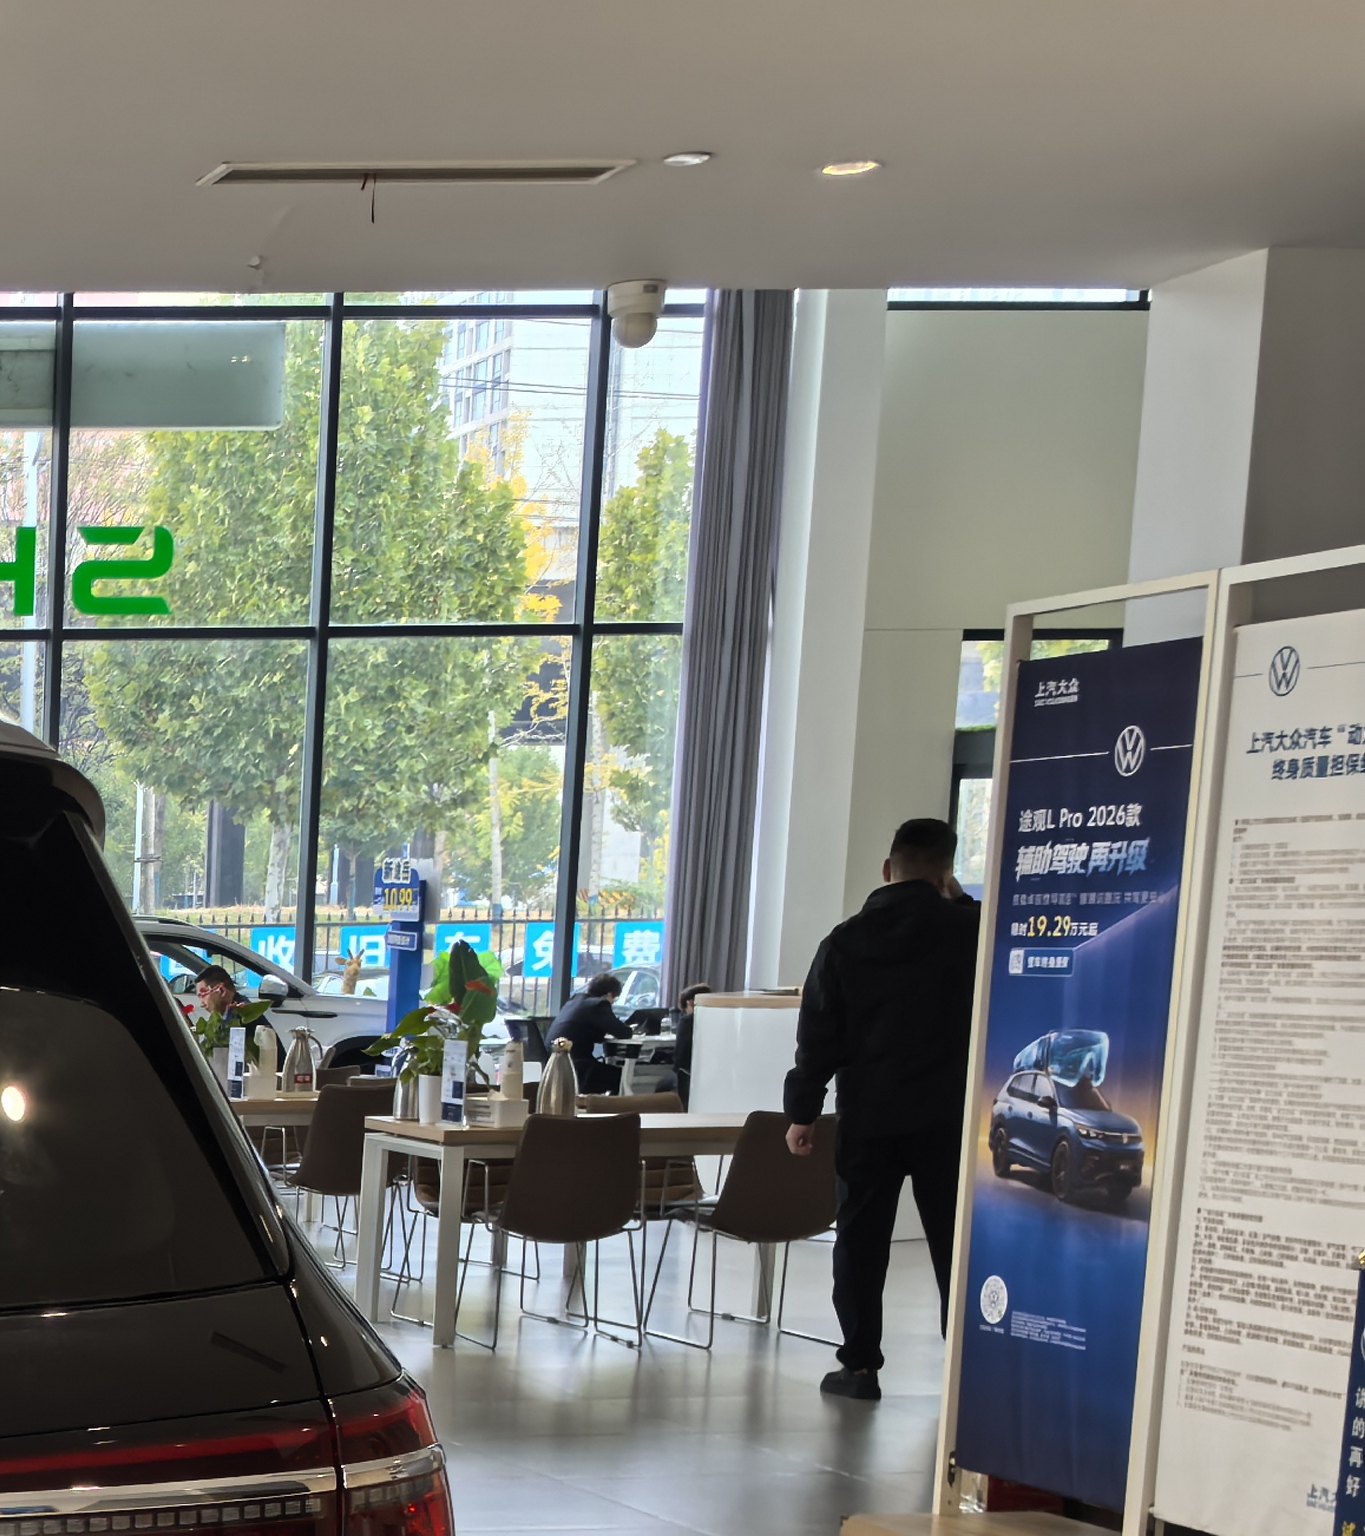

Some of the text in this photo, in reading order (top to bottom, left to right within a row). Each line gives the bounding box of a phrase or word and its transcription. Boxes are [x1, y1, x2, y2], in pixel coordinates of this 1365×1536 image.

[1034, 678, 1080, 698] 上汽大众
[1246, 724, 1365, 754] 上汽大众汽车“动
[1271, 753, 1365, 780] 终身质量担保
[1059, 808, 1083, 828] Pro
[1087, 802, 1143, 828] 2026款
